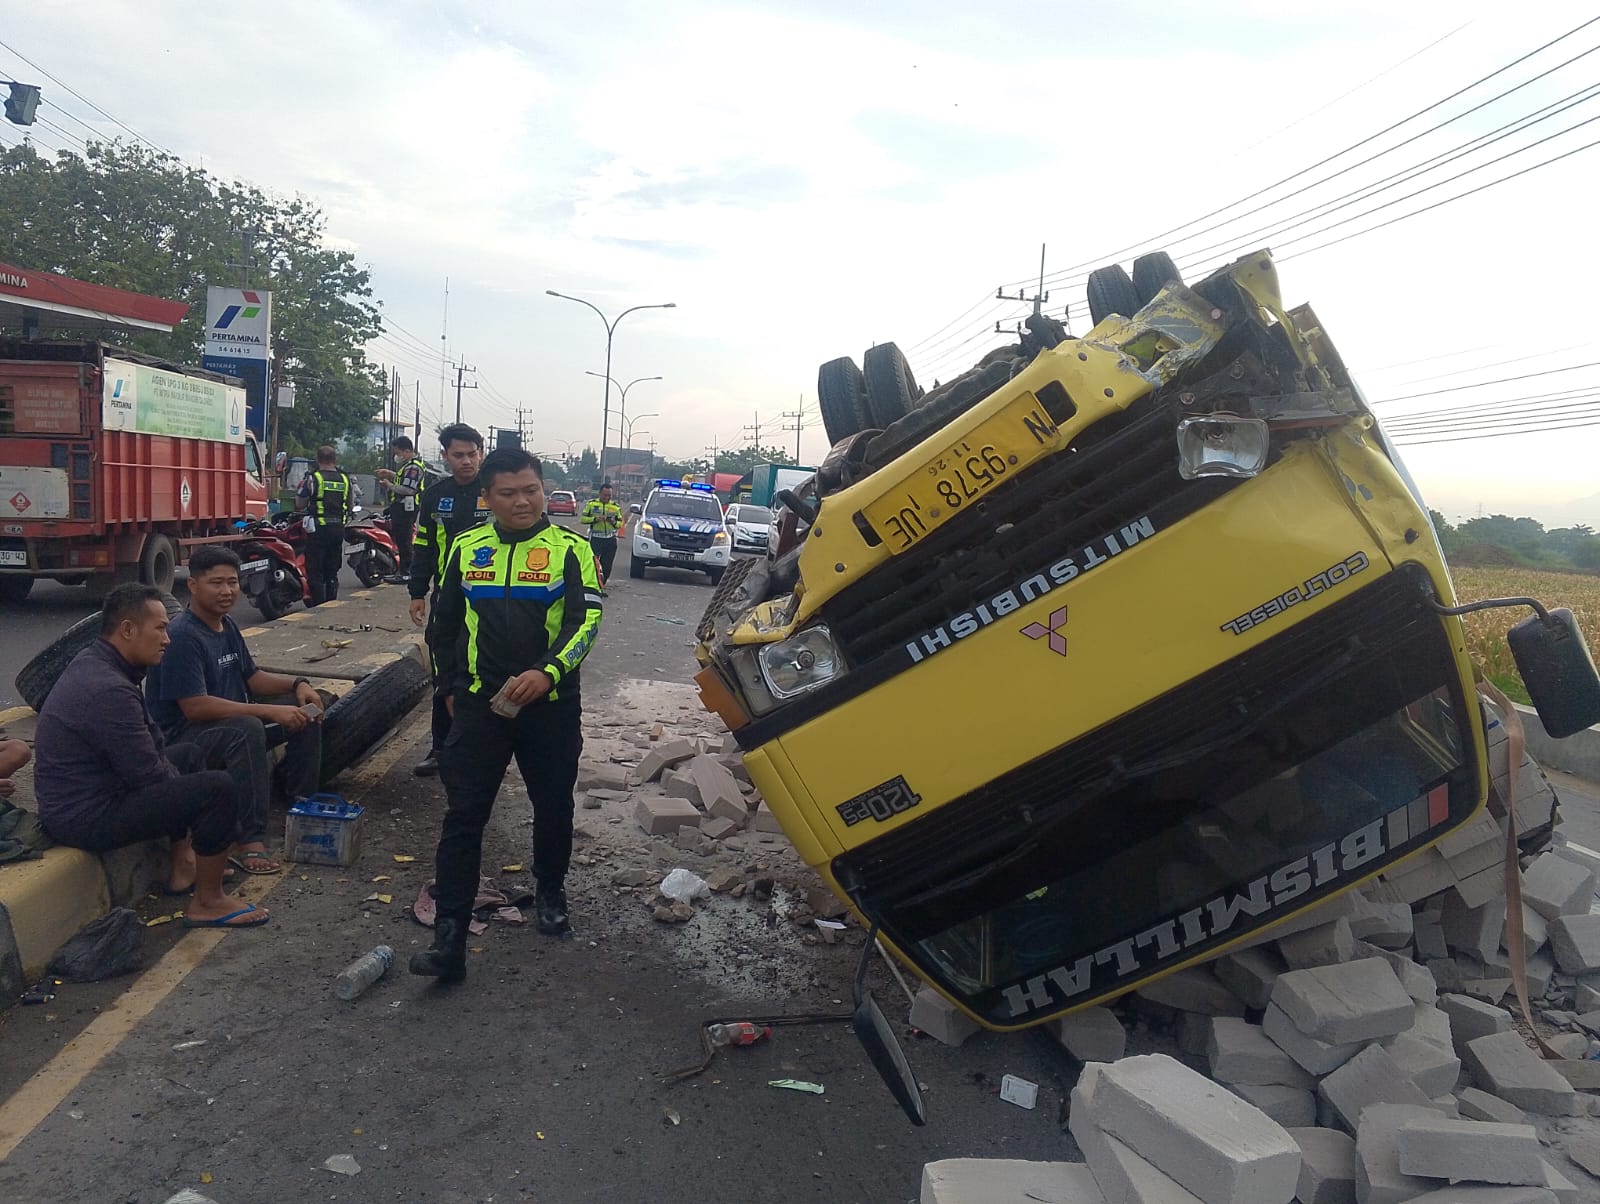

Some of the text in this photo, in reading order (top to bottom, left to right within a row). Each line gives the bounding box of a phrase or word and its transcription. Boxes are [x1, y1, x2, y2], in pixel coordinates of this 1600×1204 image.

[211, 332, 260, 343] PERTAMINA
[885, 411, 1052, 548] N 9578 UE
[467, 571, 494, 580] AGIL
[519, 572, 549, 581] POLRI
[906, 516, 1156, 663] MITSUBISHI
[1002, 816, 1387, 1018] BISMILLAH
